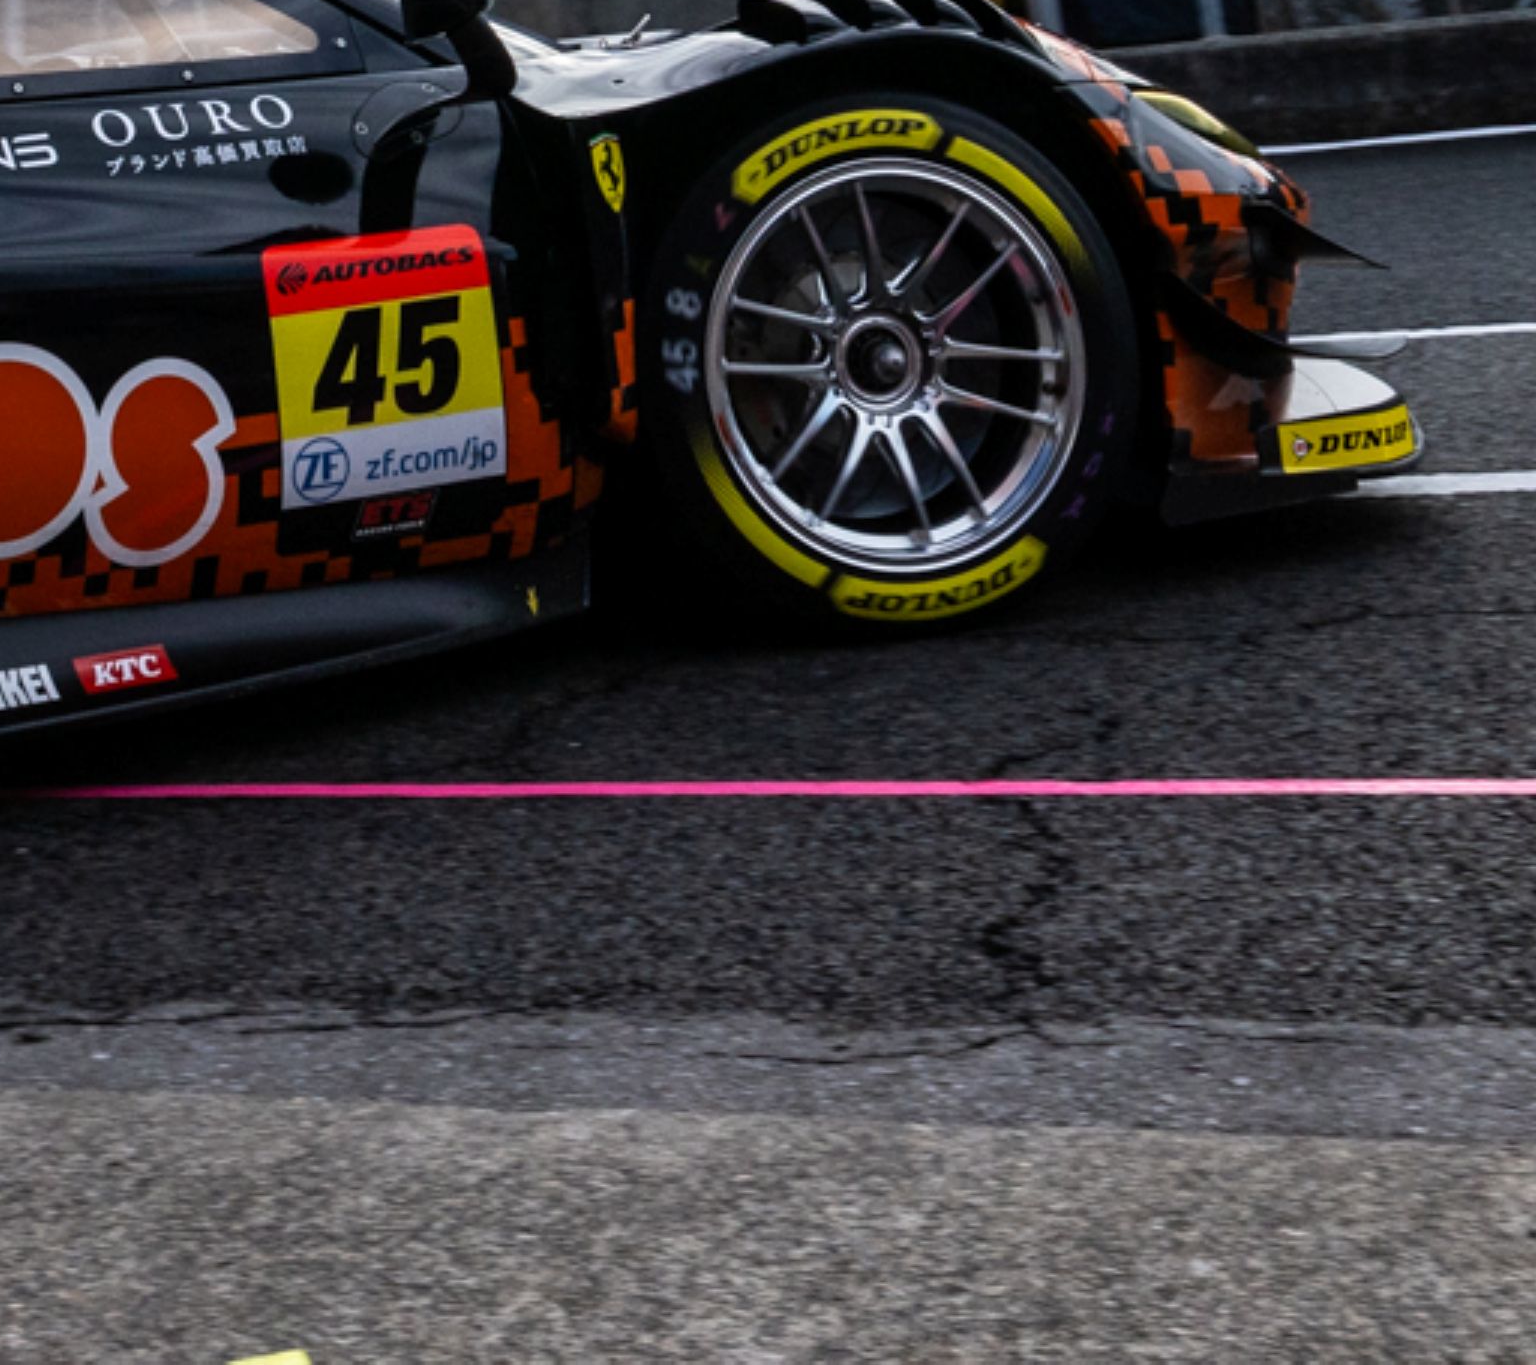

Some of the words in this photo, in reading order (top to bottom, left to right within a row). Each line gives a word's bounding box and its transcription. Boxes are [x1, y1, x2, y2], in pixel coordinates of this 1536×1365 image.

[91, 93, 293, 147] OURO
[763, 118, 926, 176] DUNLOP
[312, 246, 474, 285] AUTOBACS
[311, 295, 461, 426] 45
[300, 450, 339, 492] ZF
[366, 436, 497, 480] zf.com/jp
[843, 563, 1014, 612] DUNLOP
[94, 653, 163, 687] KTC
